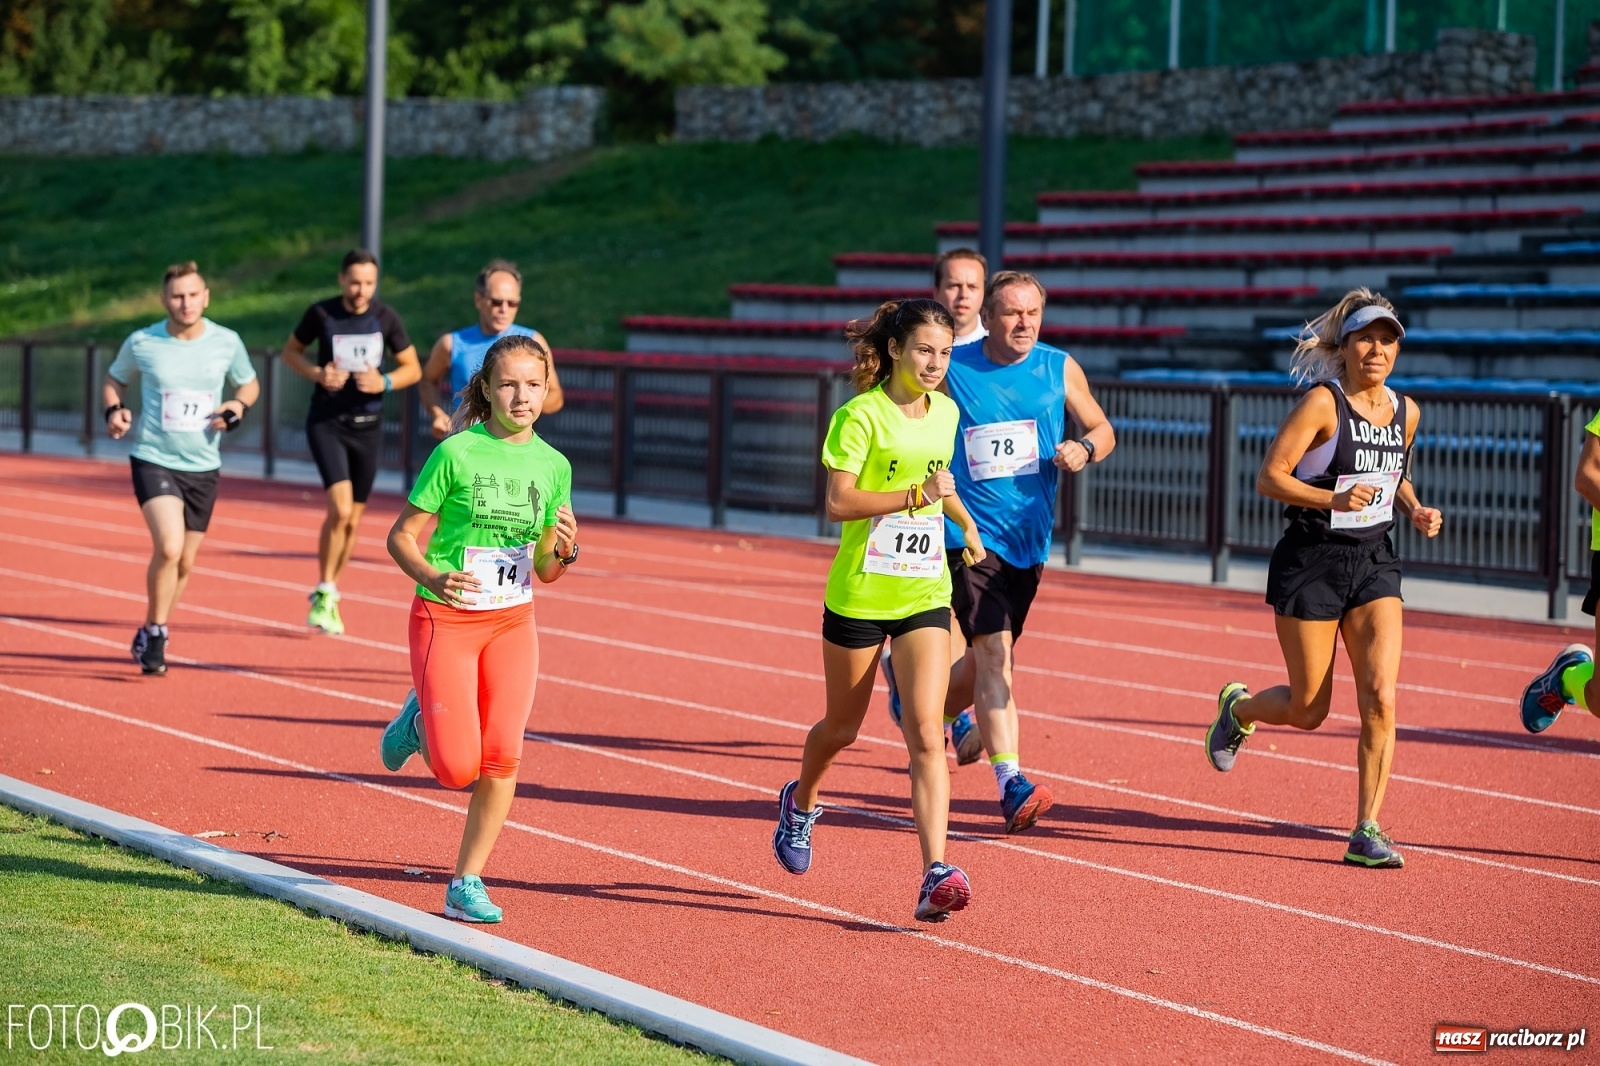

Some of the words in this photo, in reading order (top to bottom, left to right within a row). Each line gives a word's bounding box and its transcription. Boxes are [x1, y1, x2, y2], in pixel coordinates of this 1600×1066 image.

[183, 403, 198, 415] 77
[1349, 419, 1402, 446] LOCALS
[991, 438, 1014, 457] 78
[887, 460, 898, 481] 5
[1355, 448, 1403, 472] ONLINE
[490, 515, 532, 525] PROFILAKTYCZNY
[895, 532, 930, 554] 120
[497, 565, 517, 586] 14
